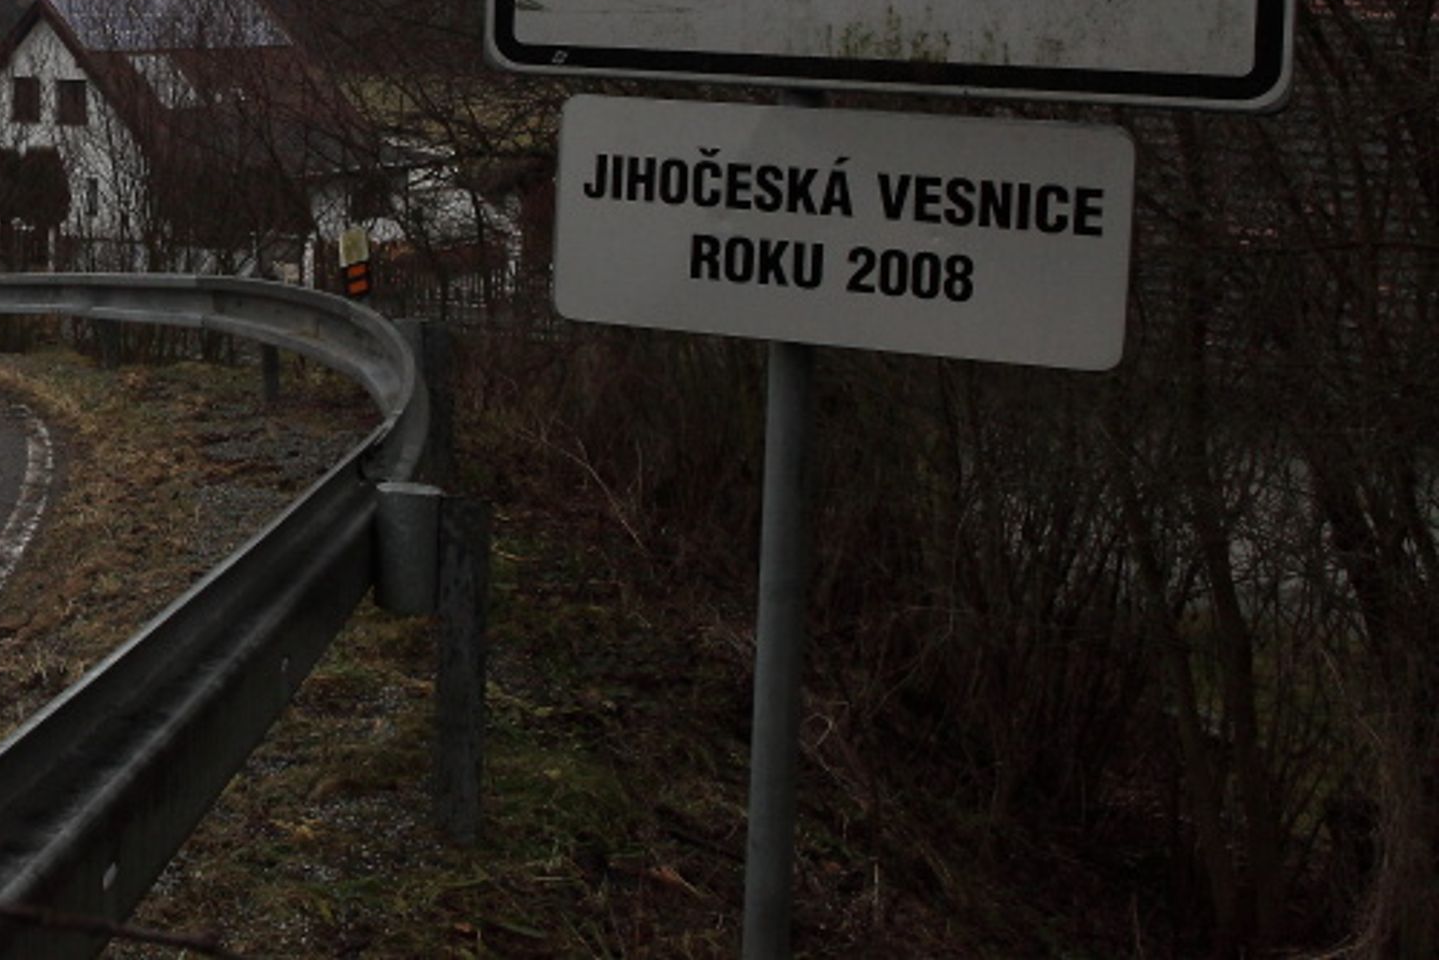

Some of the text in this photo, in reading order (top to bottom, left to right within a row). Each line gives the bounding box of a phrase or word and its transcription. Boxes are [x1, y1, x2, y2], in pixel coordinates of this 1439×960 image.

[583, 147, 1104, 237] JIHOČESKÁ VESNICE
[688, 233, 975, 303] ROKU 2008
